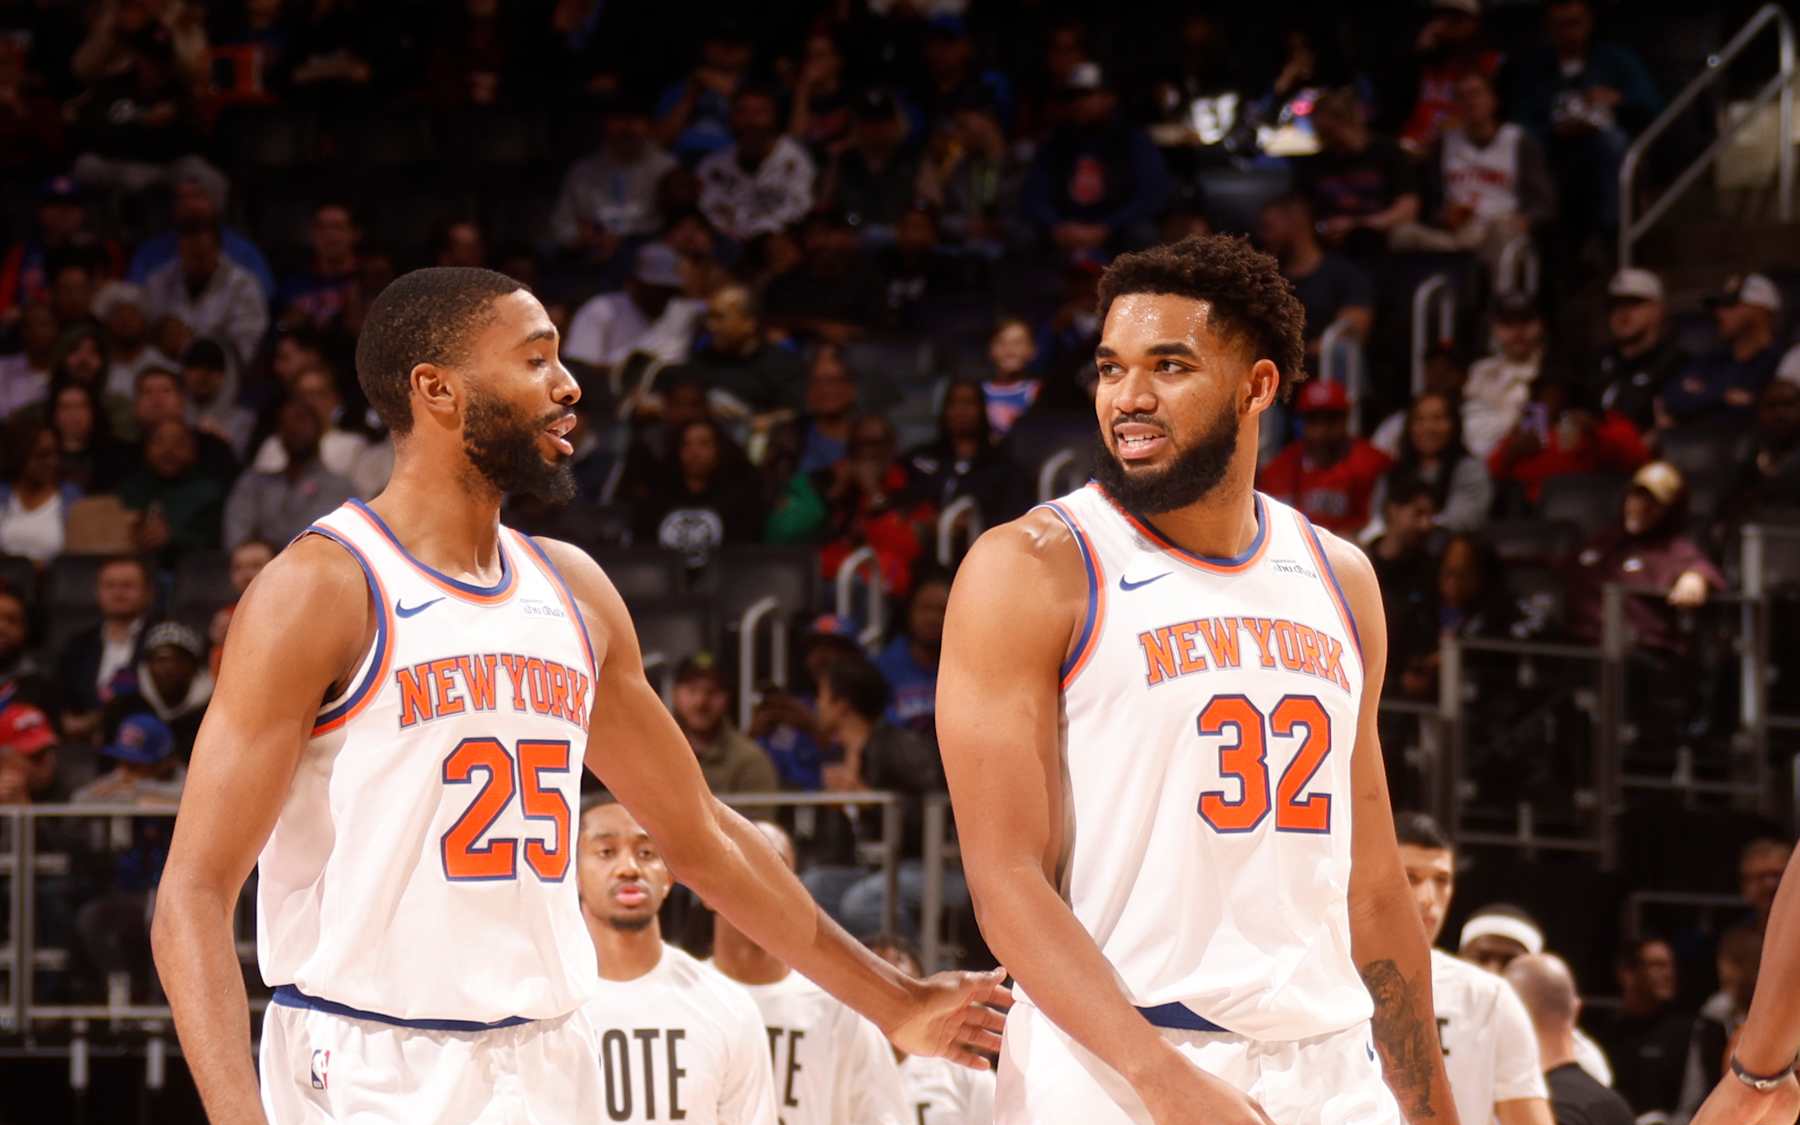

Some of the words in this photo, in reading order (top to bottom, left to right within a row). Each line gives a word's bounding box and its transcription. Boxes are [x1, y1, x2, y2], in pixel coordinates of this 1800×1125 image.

[395, 653, 497, 728] NEW
[501, 652, 588, 735] YORK
[1138, 616, 1242, 687] NEW
[1241, 617, 1351, 695] YORK
[441, 737, 571, 882] 25
[1196, 693, 1332, 834] 32
[600, 1028, 687, 1121] OTE
